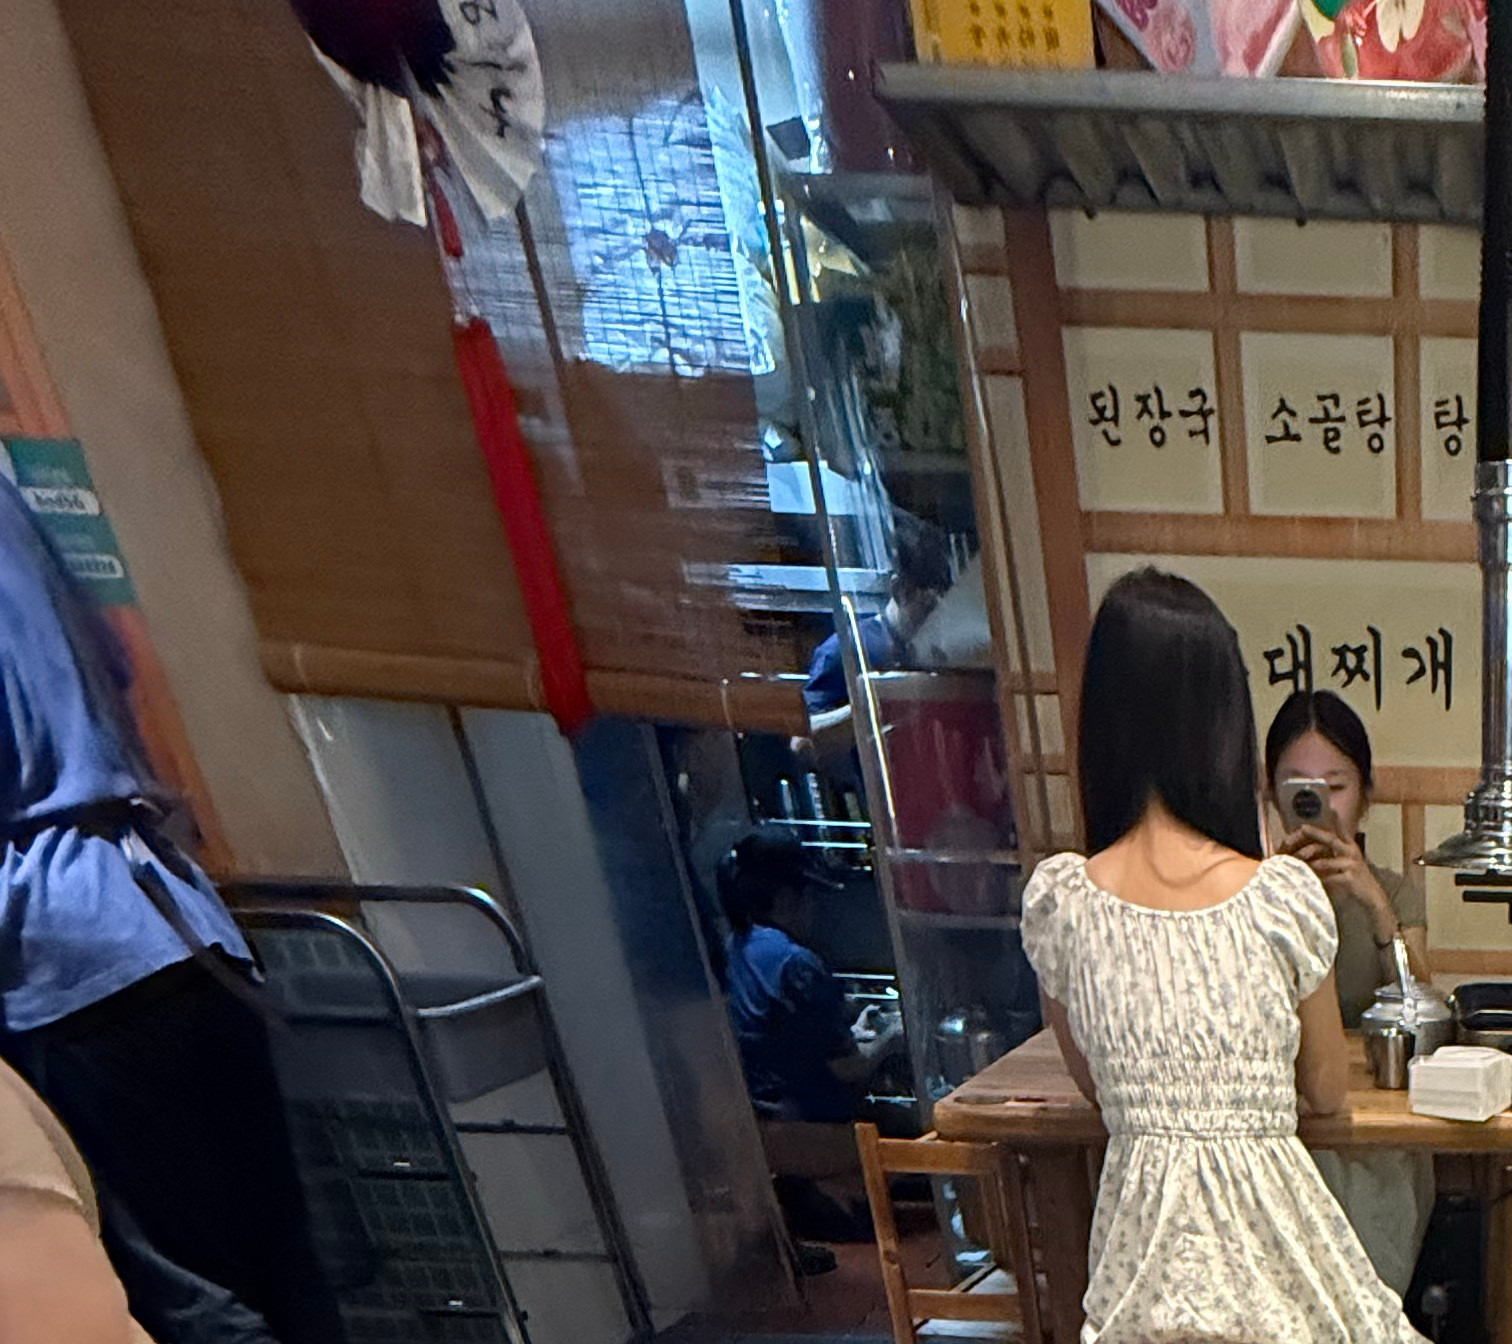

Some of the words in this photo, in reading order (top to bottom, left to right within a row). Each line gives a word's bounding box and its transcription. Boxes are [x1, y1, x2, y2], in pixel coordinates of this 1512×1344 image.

[1087, 382, 1216, 449] 된장국
[1264, 392, 1393, 455] 소골탕
[1263, 623, 1455, 711] 대찌개
